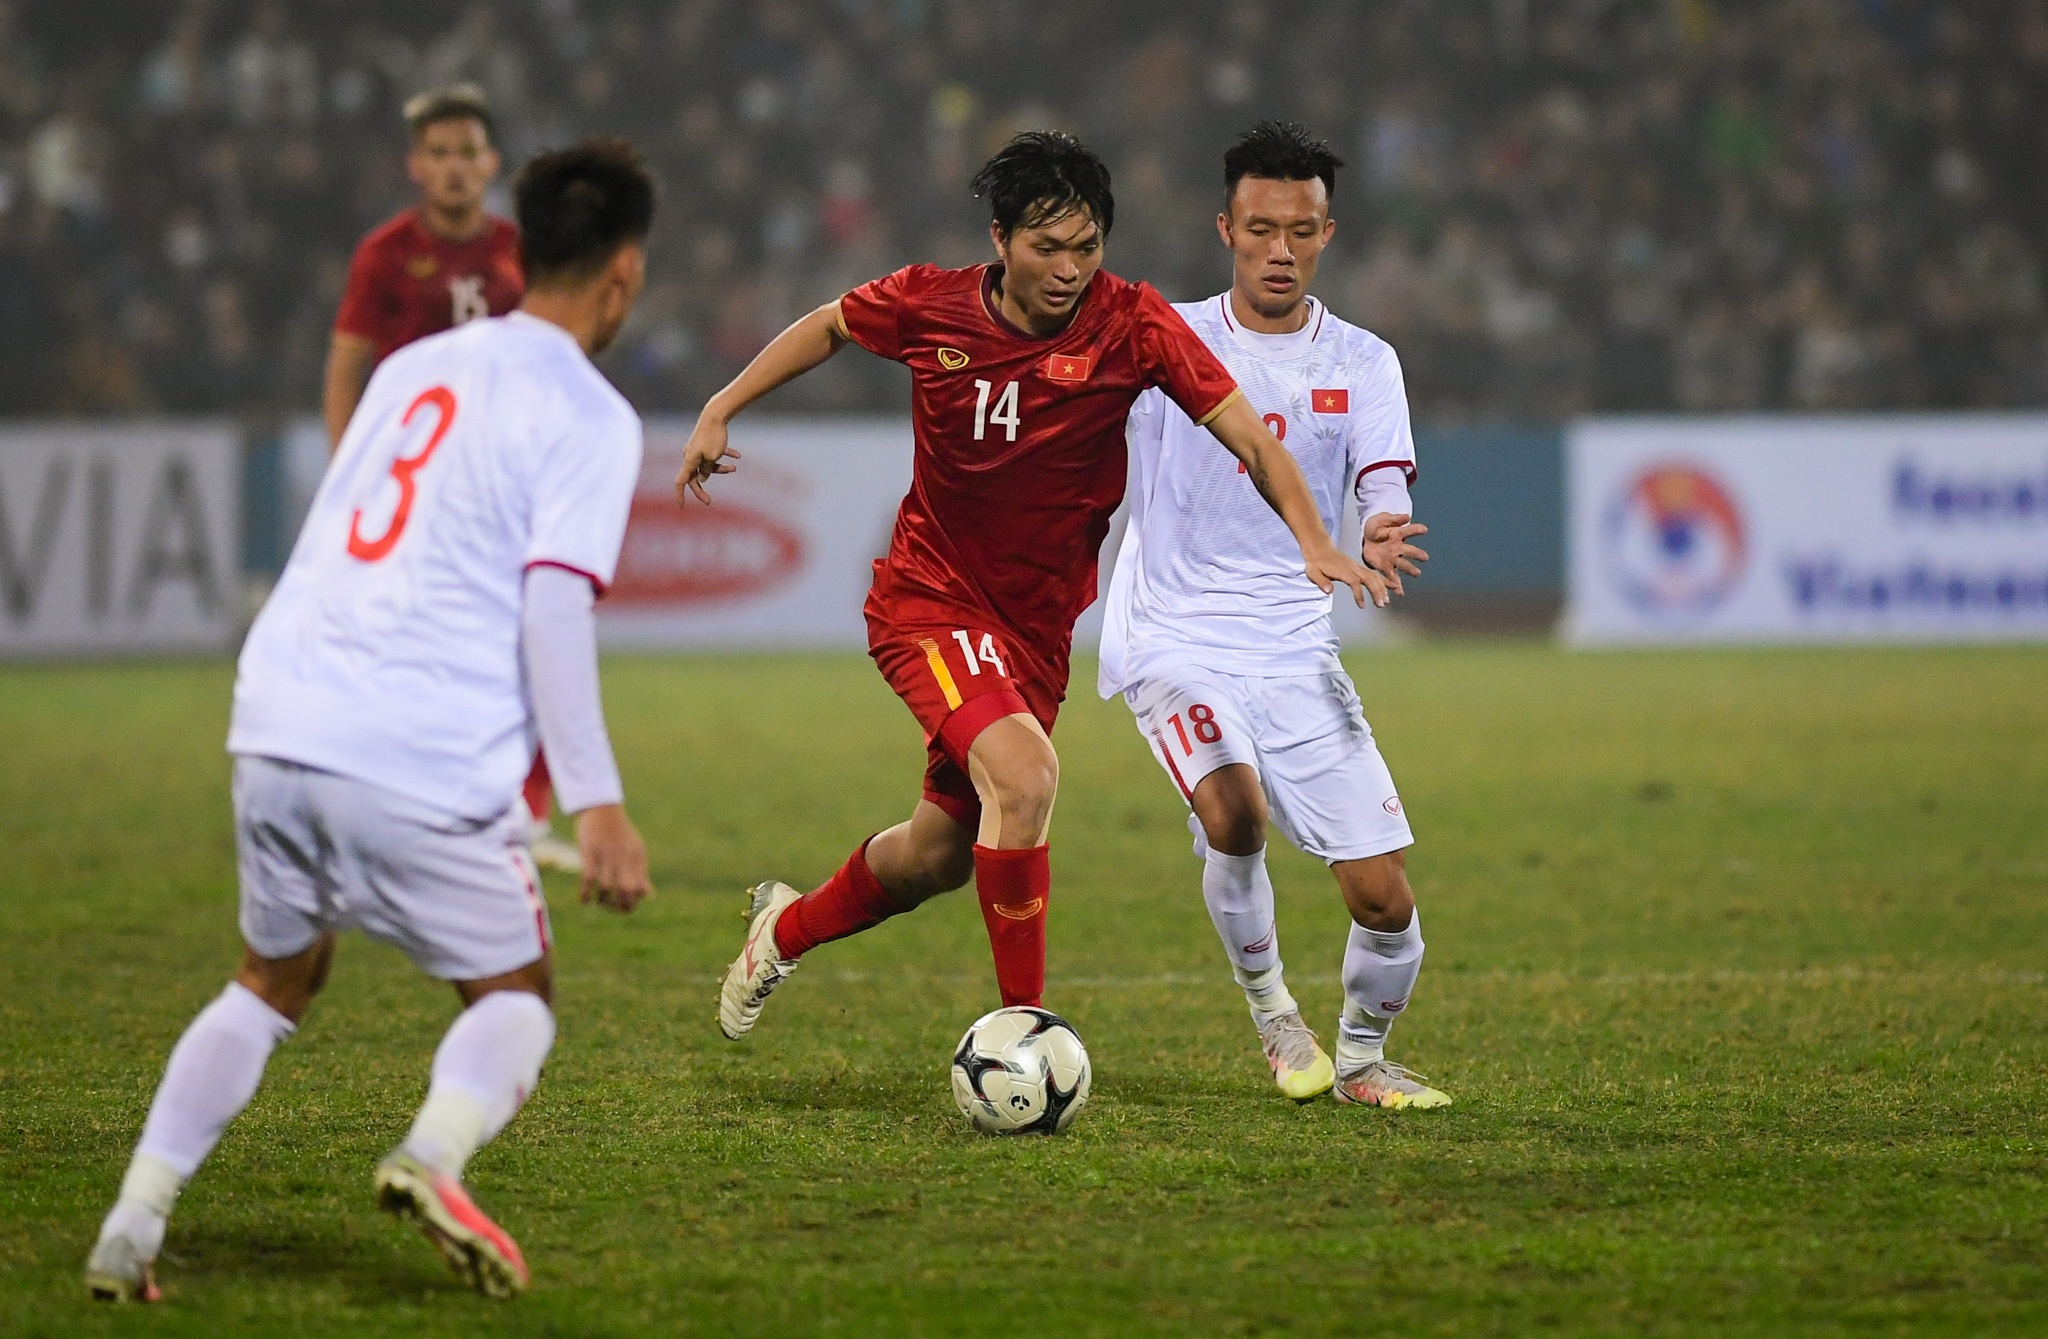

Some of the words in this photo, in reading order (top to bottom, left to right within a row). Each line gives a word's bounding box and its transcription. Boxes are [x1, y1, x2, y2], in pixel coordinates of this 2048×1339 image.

[973, 378, 1021, 442] 14
[347, 385, 457, 563] 3
[951, 629, 1006, 678] 14
[1167, 703, 1223, 757] 18
